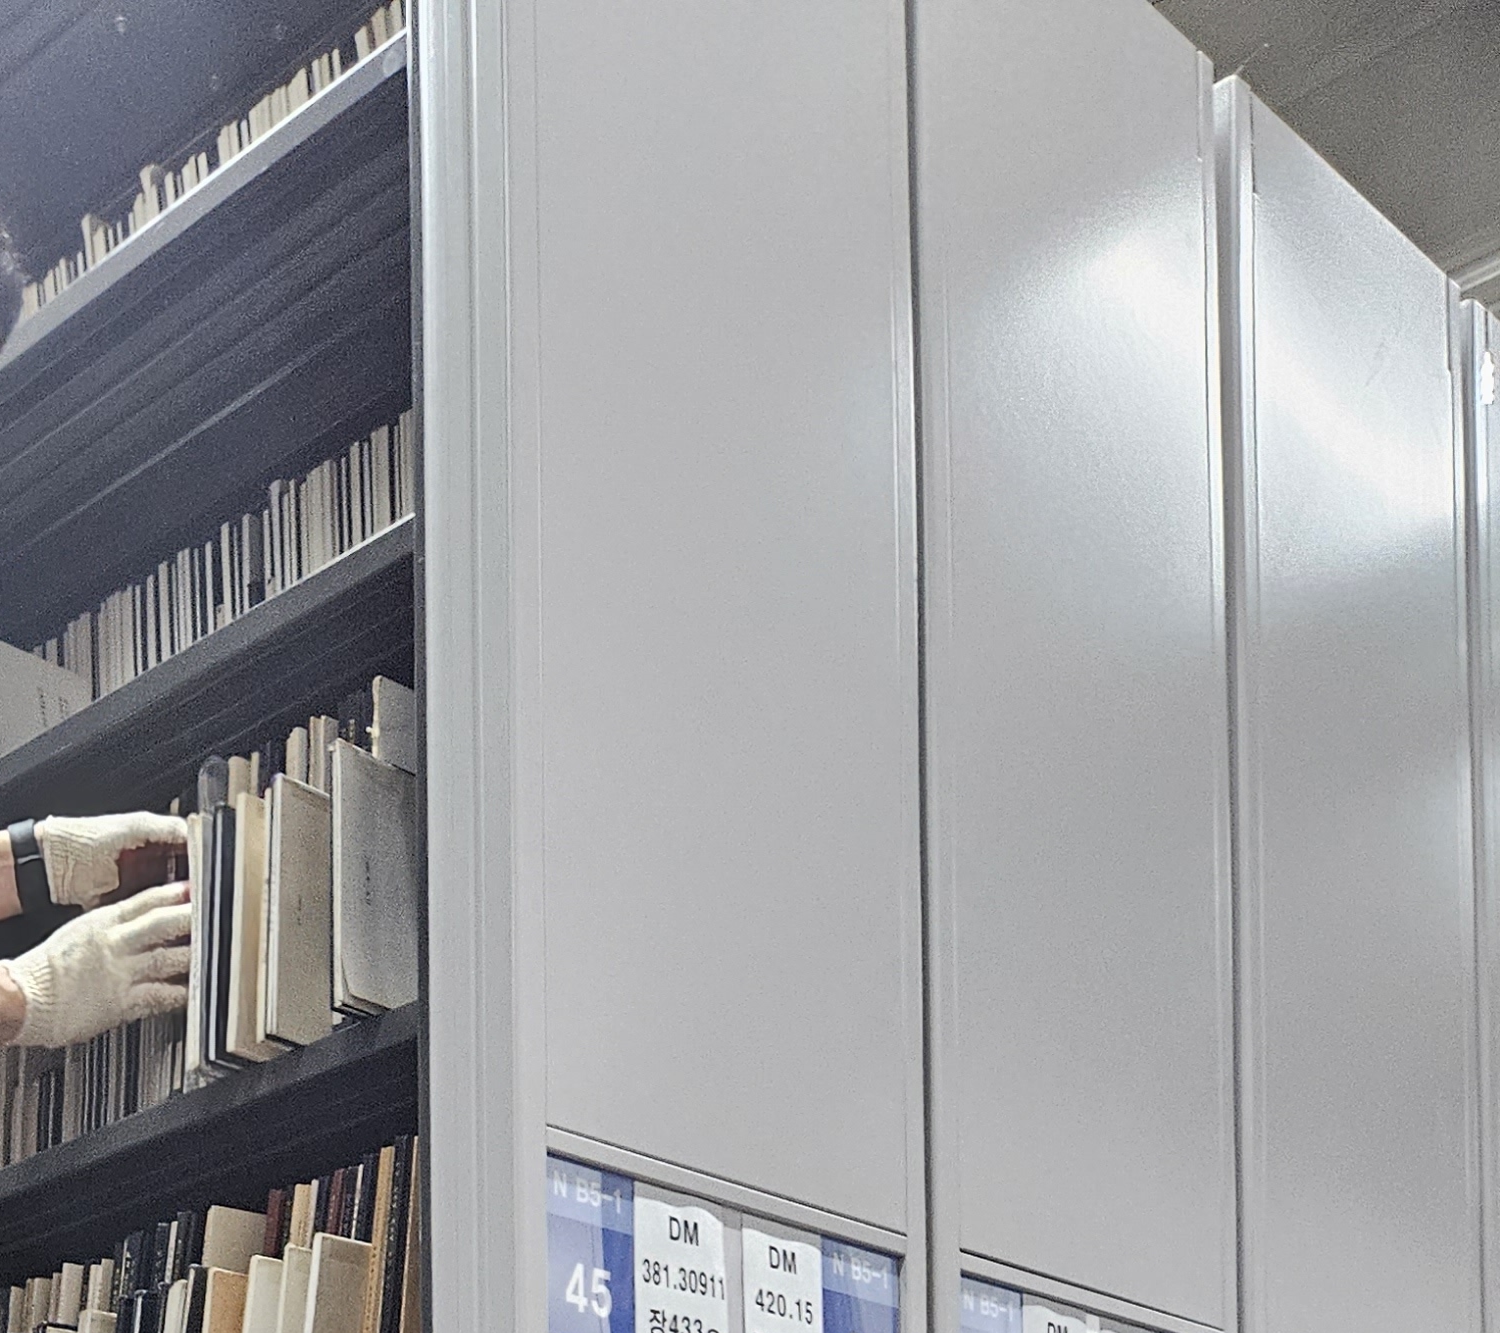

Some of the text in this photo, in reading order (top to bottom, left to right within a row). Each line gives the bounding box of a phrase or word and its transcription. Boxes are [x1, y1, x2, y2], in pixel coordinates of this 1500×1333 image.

[553, 1178, 622, 1214] N B5-1
[669, 1216, 700, 1247] DM
[768, 1246, 797, 1275] DM
[832, 1259, 888, 1289] N B5-1
[565, 1263, 613, 1318] 45
[642, 1259, 726, 1301] 381.30911
[754, 1288, 814, 1326] 420.15
